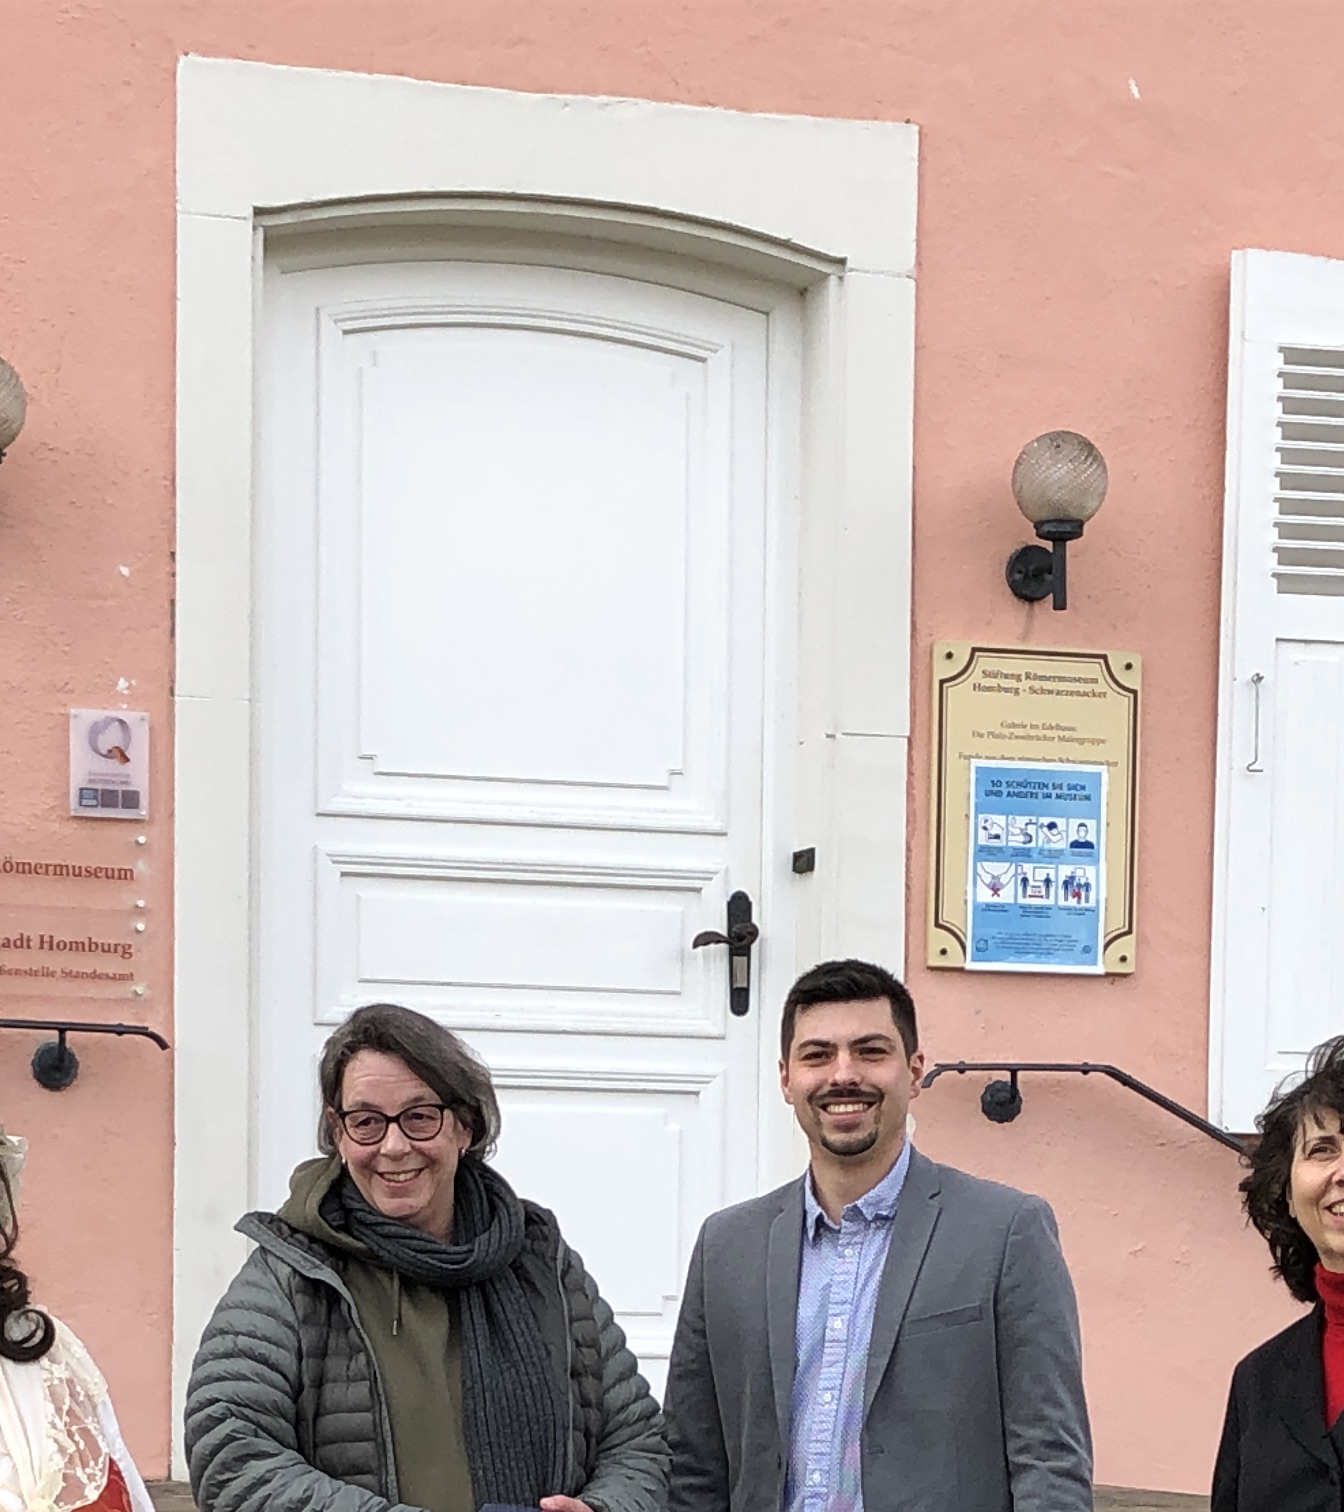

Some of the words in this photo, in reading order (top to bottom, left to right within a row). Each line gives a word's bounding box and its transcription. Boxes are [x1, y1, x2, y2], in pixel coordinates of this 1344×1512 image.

[972, 682, 1020, 696] Homburg
[984, 789, 1004, 798] UND
[38, 933, 134, 960] Homburg
[60, 966, 136, 982] Standesamt
